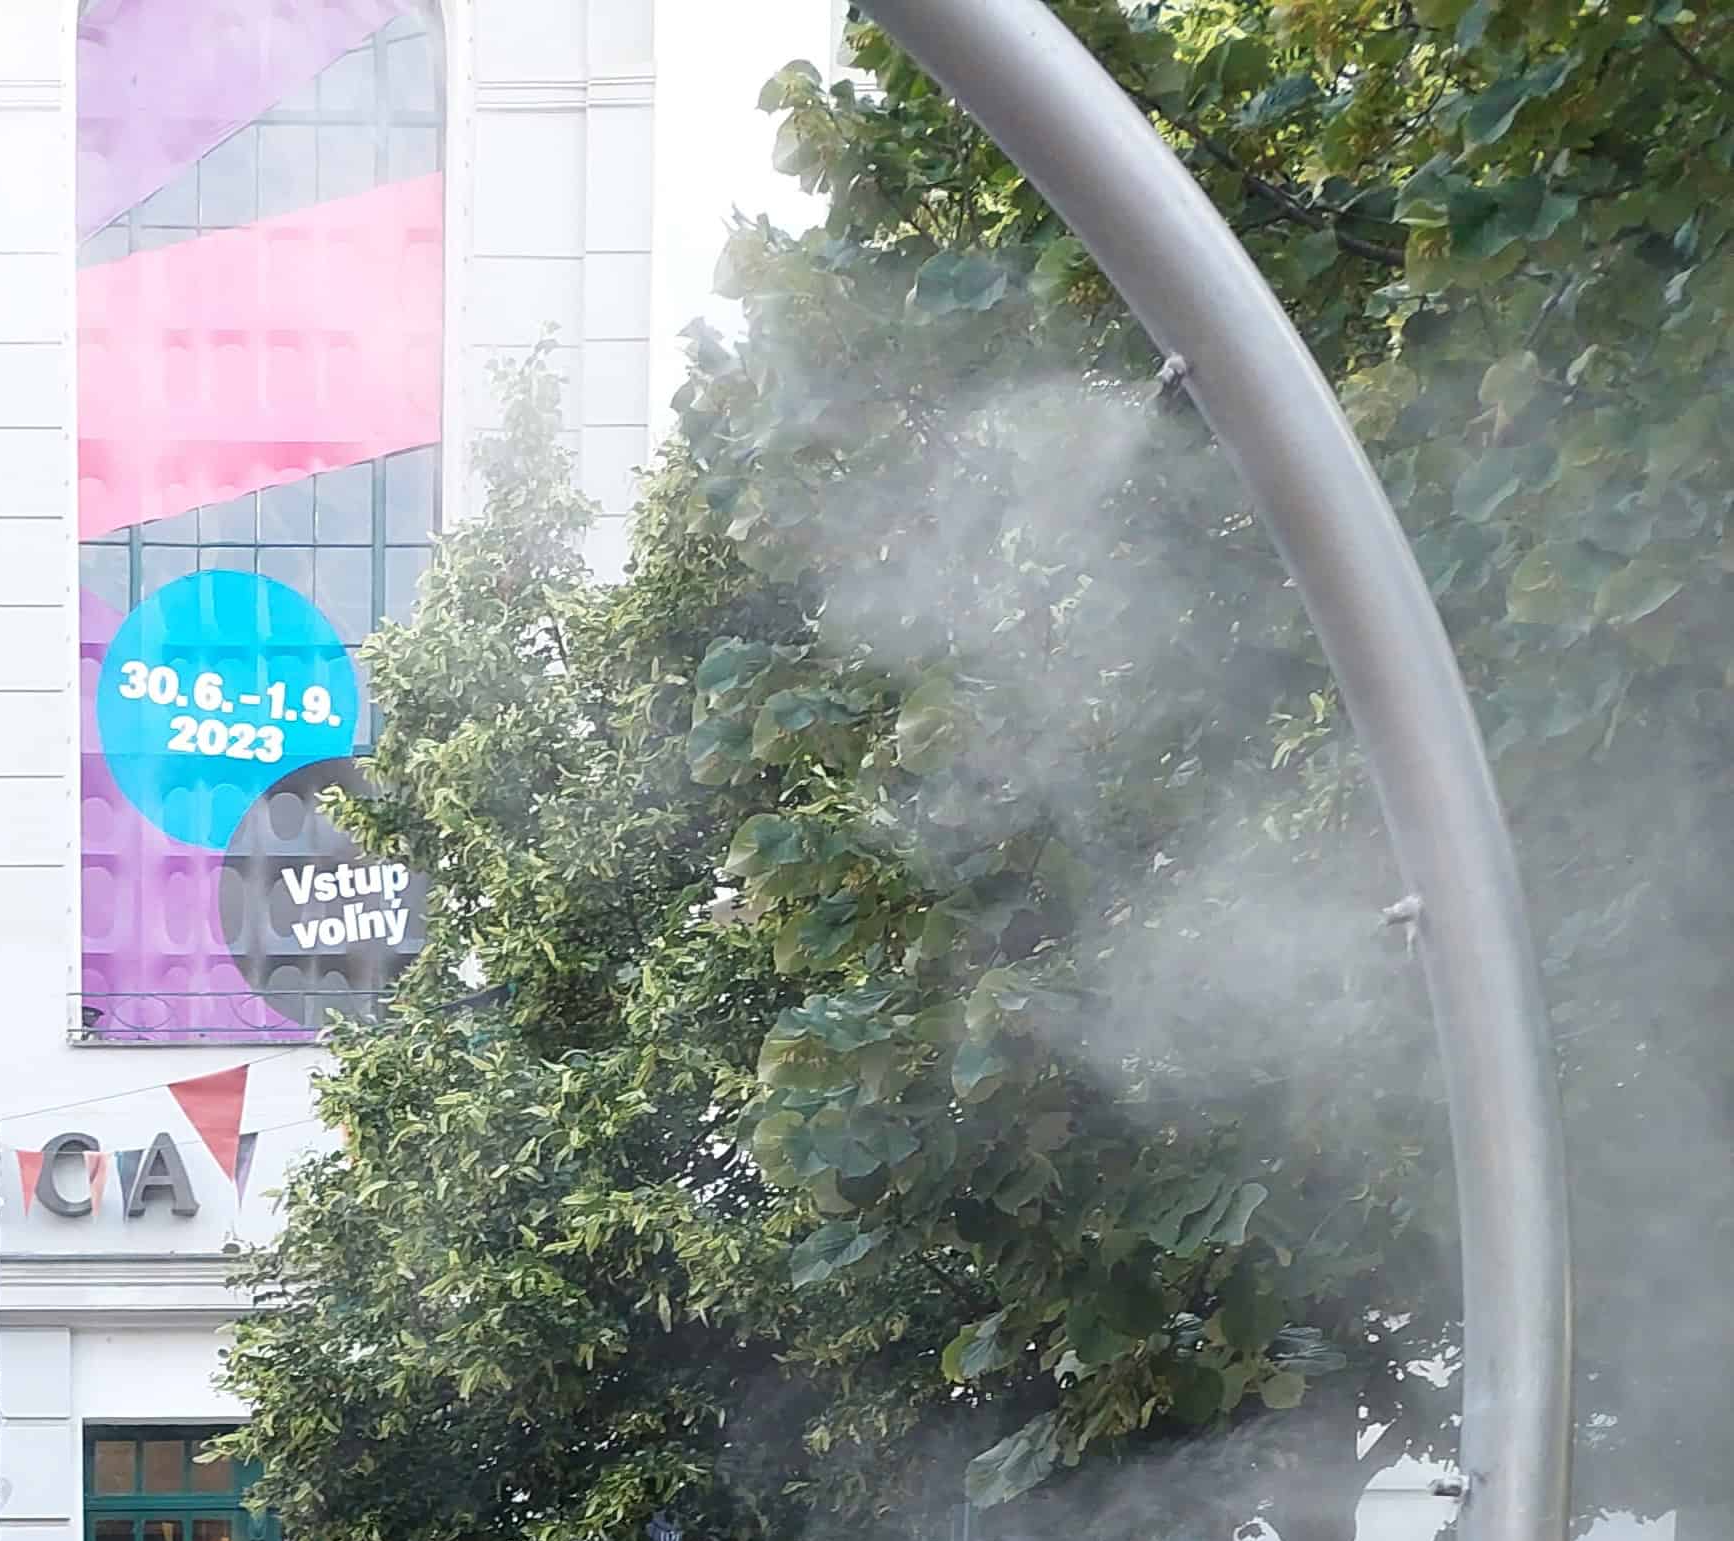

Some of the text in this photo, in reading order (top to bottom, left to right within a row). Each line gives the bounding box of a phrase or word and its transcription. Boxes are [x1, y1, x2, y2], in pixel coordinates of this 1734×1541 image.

[168, 715, 284, 763] 2023
[282, 862, 410, 905] Vstup
[292, 899, 409, 950] voľný
